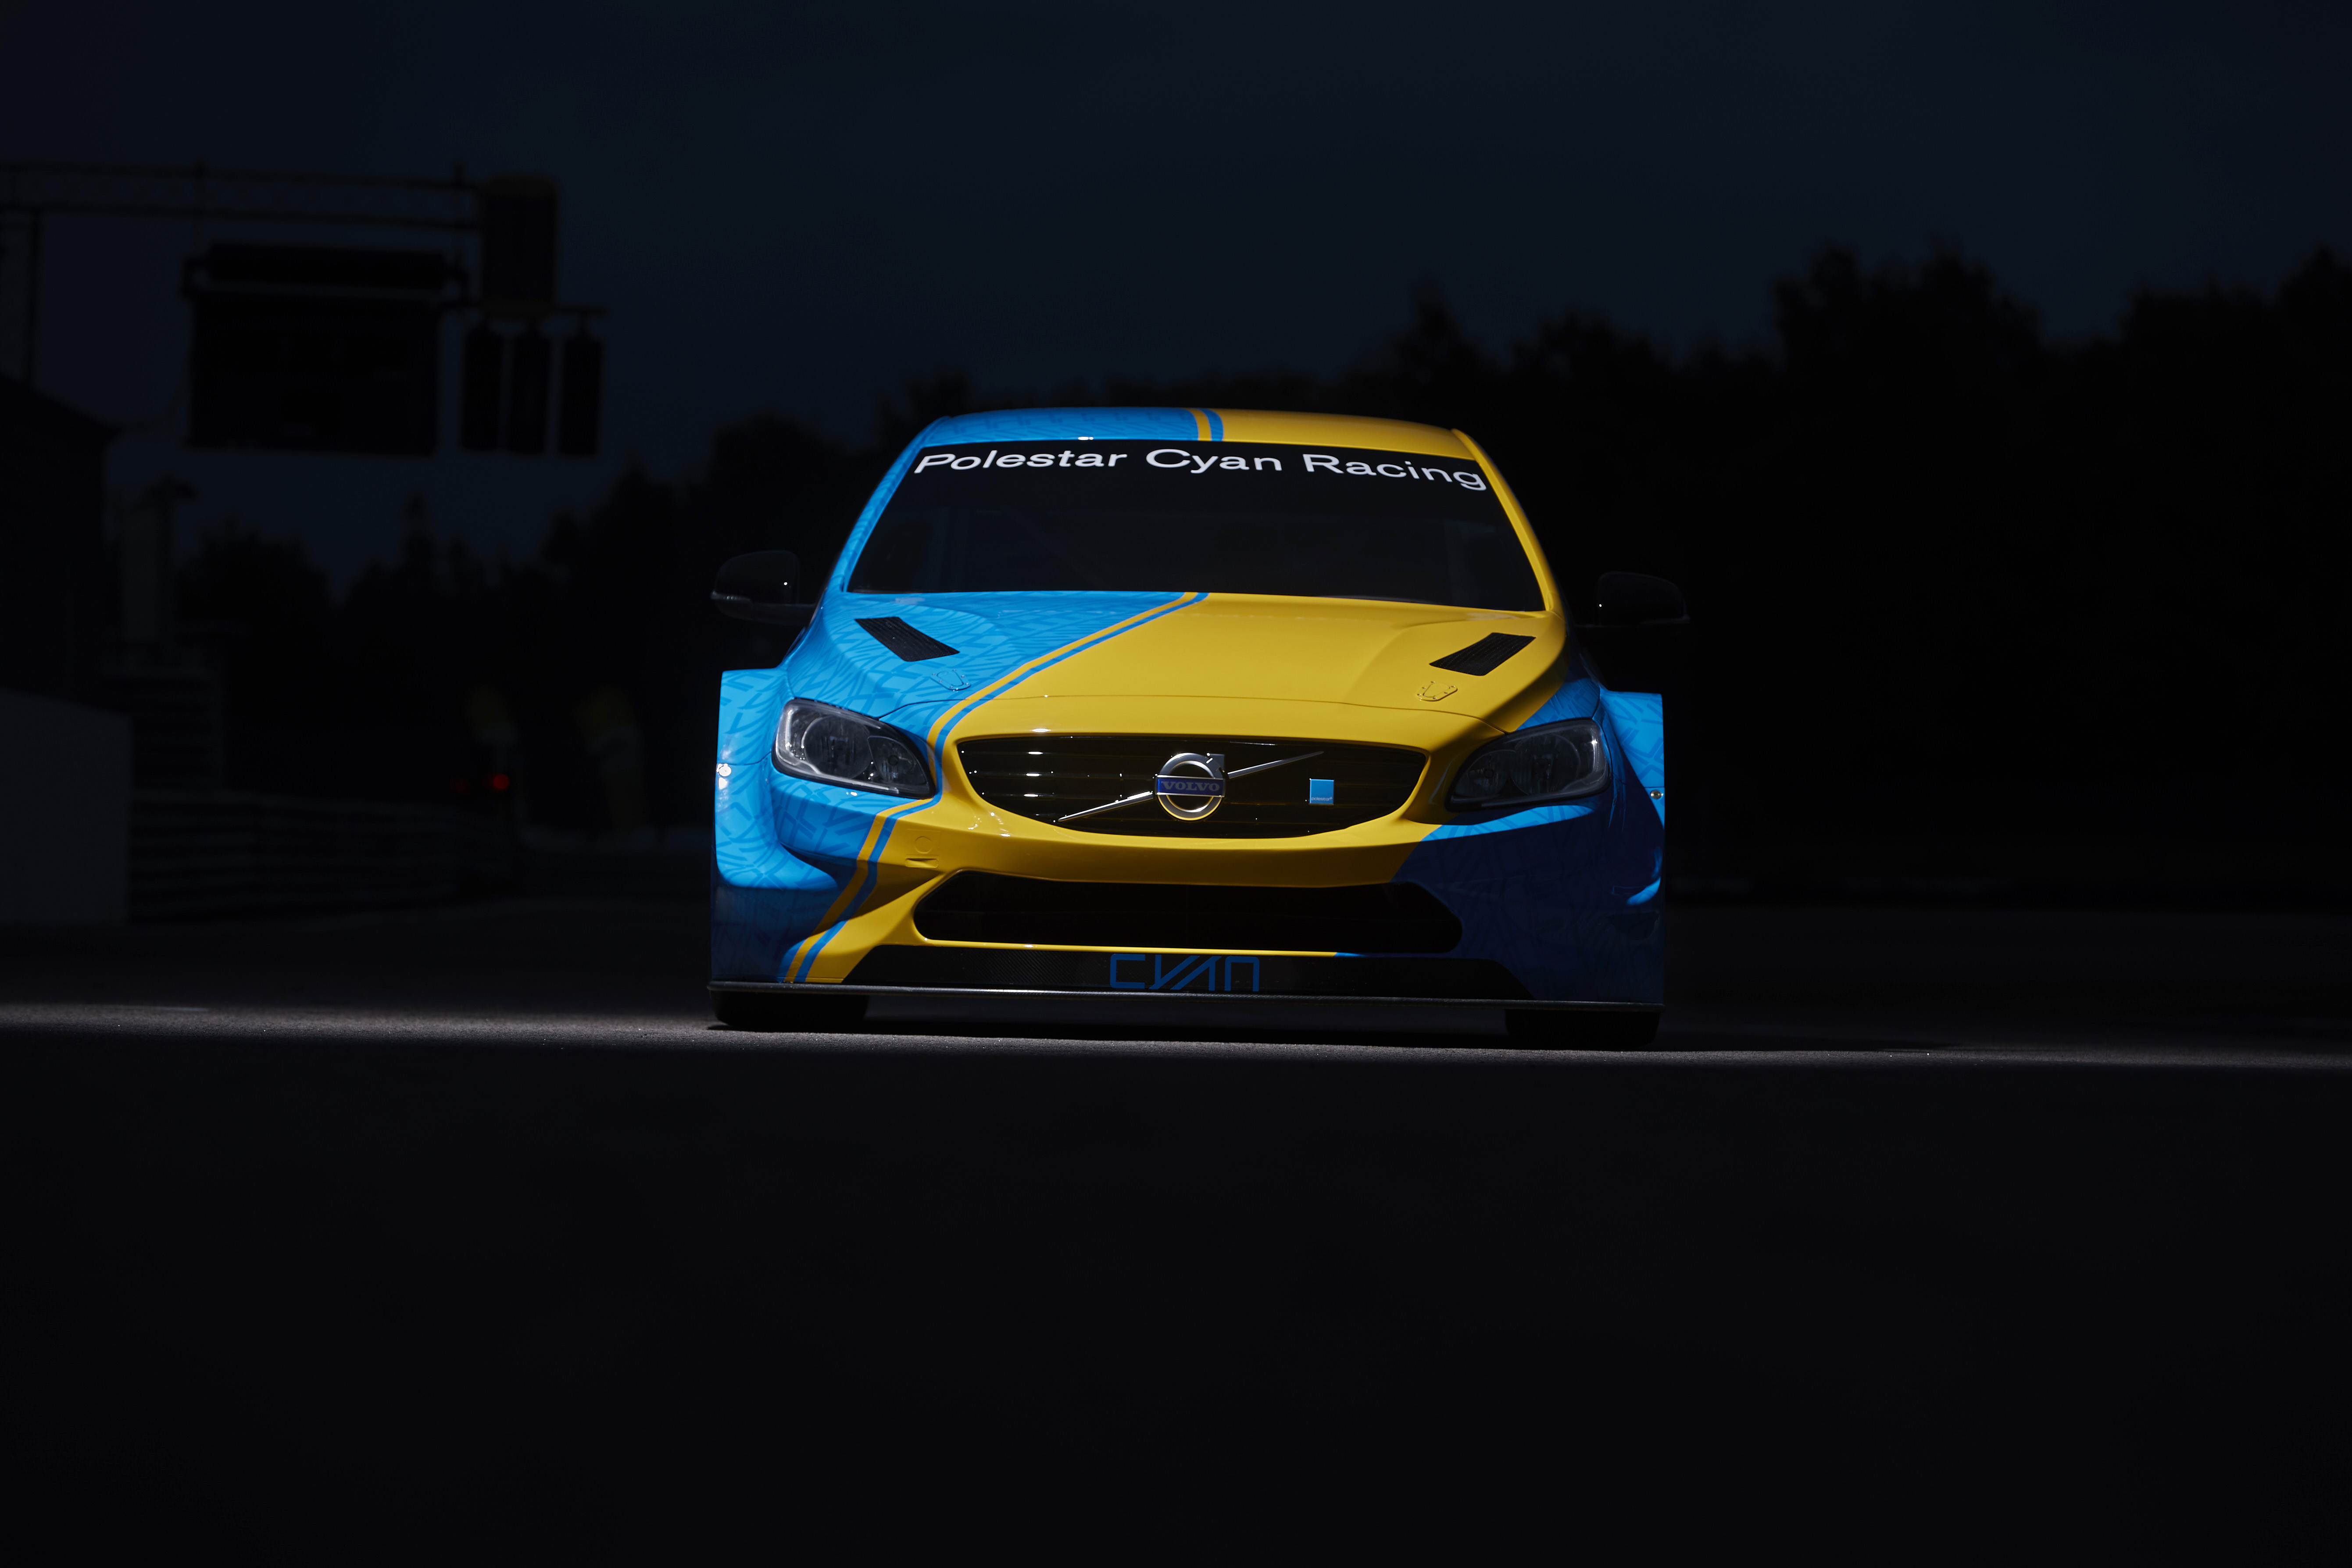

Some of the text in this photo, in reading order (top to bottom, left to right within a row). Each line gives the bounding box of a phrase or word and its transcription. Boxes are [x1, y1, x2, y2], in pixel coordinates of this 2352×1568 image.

[914, 449, 1487, 491] Polestar Cyan Racing
[1161, 781, 1220, 792] VOLVO
